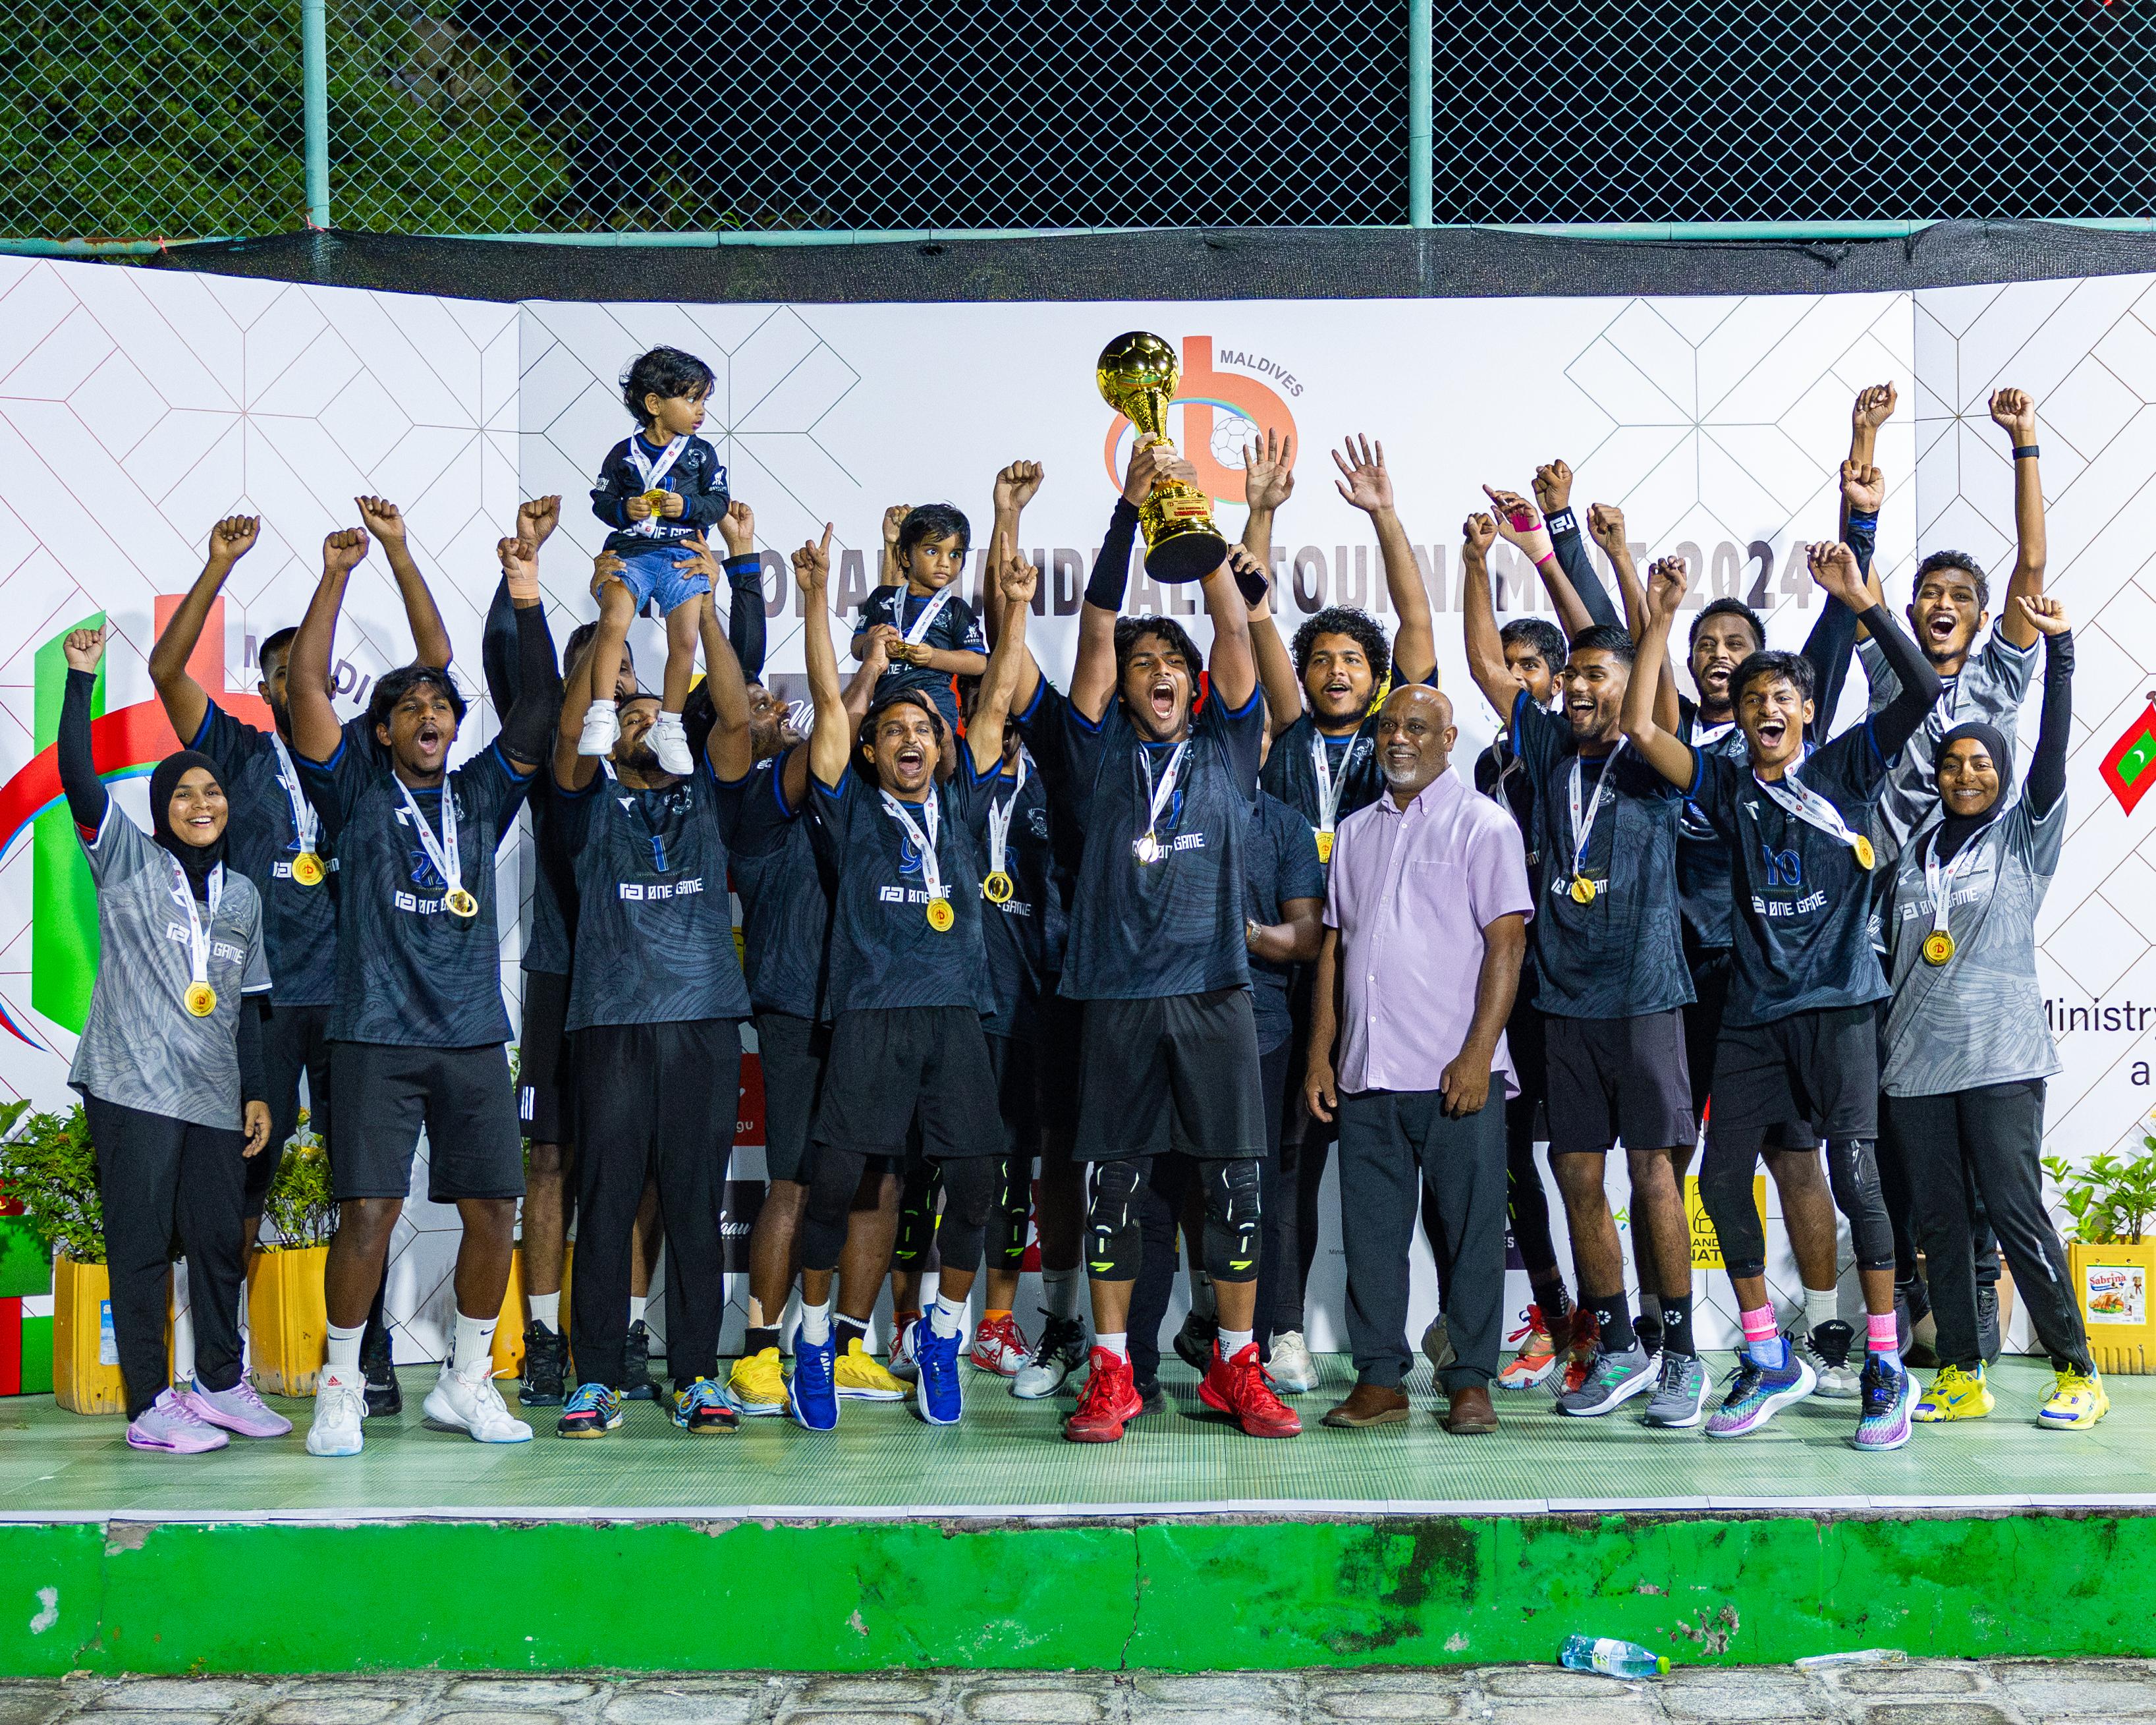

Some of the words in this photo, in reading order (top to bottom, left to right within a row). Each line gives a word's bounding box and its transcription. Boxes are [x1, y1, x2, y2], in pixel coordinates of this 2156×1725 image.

[1220, 349, 1304, 397] MALDIVES
[1676, 540, 1813, 610] 2024
[648, 835, 669, 872] 1
[1174, 833, 1205, 851] GAME
[1762, 845, 1801, 886] 10
[675, 877, 704, 895] GAME
[1002, 899, 1032, 917] GAME
[1796, 890, 1827, 914] GAME
[213, 942, 244, 965] GAME
[2089, 1272, 2126, 1285] Sabrina
